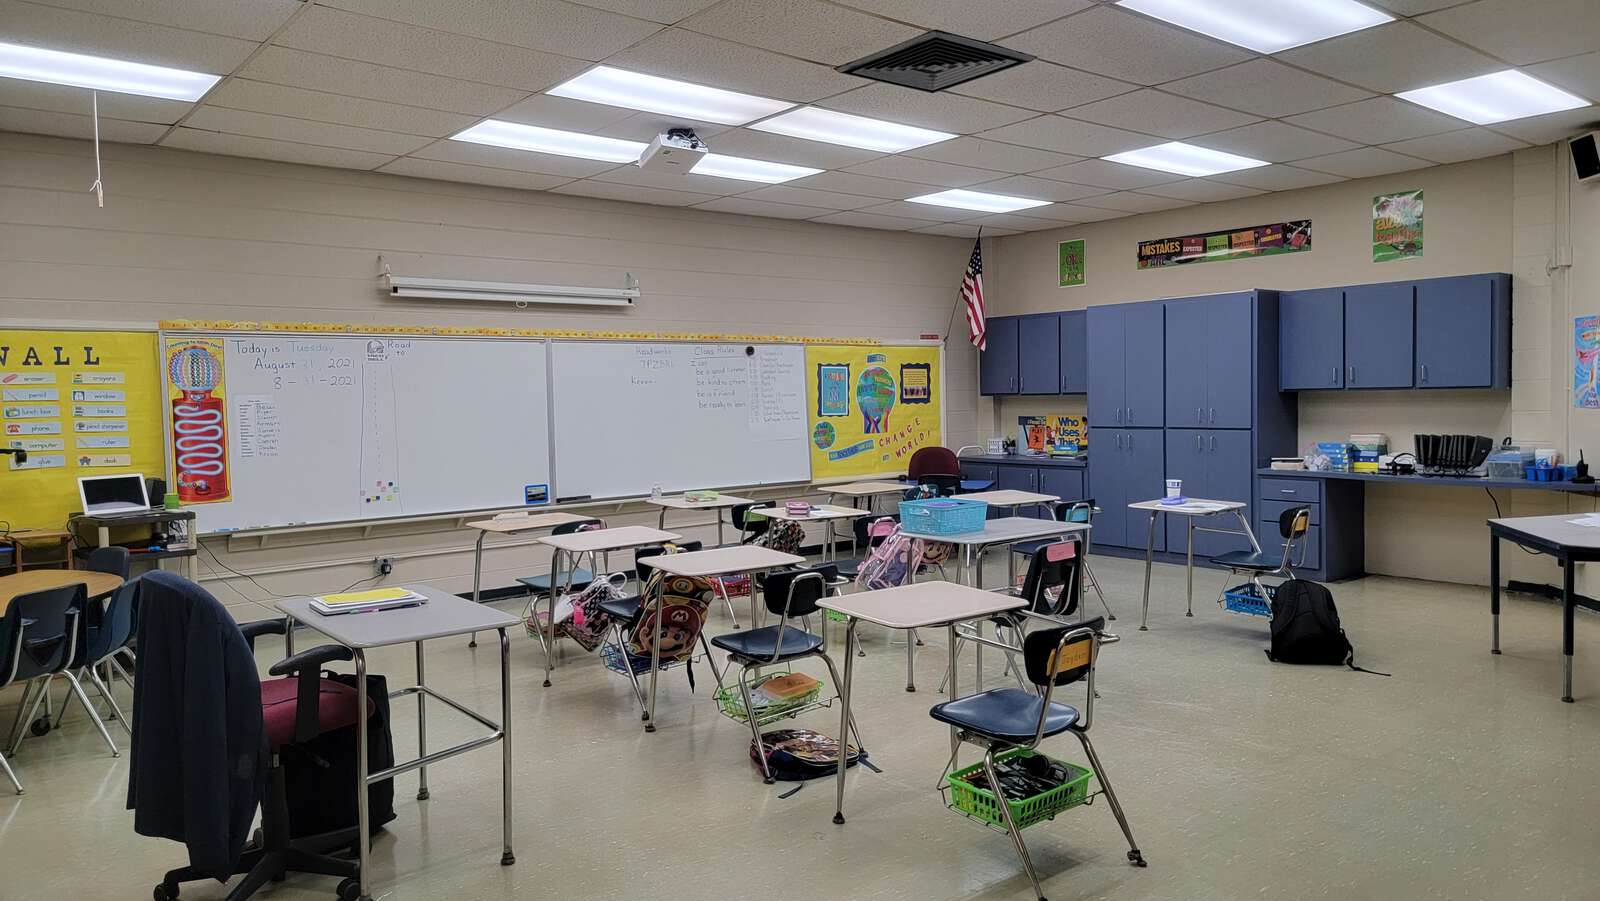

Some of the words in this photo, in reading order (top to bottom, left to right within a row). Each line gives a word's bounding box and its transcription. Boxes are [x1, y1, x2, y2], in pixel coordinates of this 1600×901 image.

[1141, 241, 1181, 257] MISTAKES
[229, 340, 268, 358] Today
[286, 341, 334, 354] Tuesday
[694, 344, 714, 355] Class
[253, 357, 296, 374] August
[327, 358, 356, 369] 2021
[272, 376, 282, 390] 8
[329, 375, 357, 386] 2021
[1058, 416, 1080, 427] Who
[879, 416, 921, 447] CHANGE
[1059, 427, 1081, 437] Uses
[671, 610, 689, 621] M
